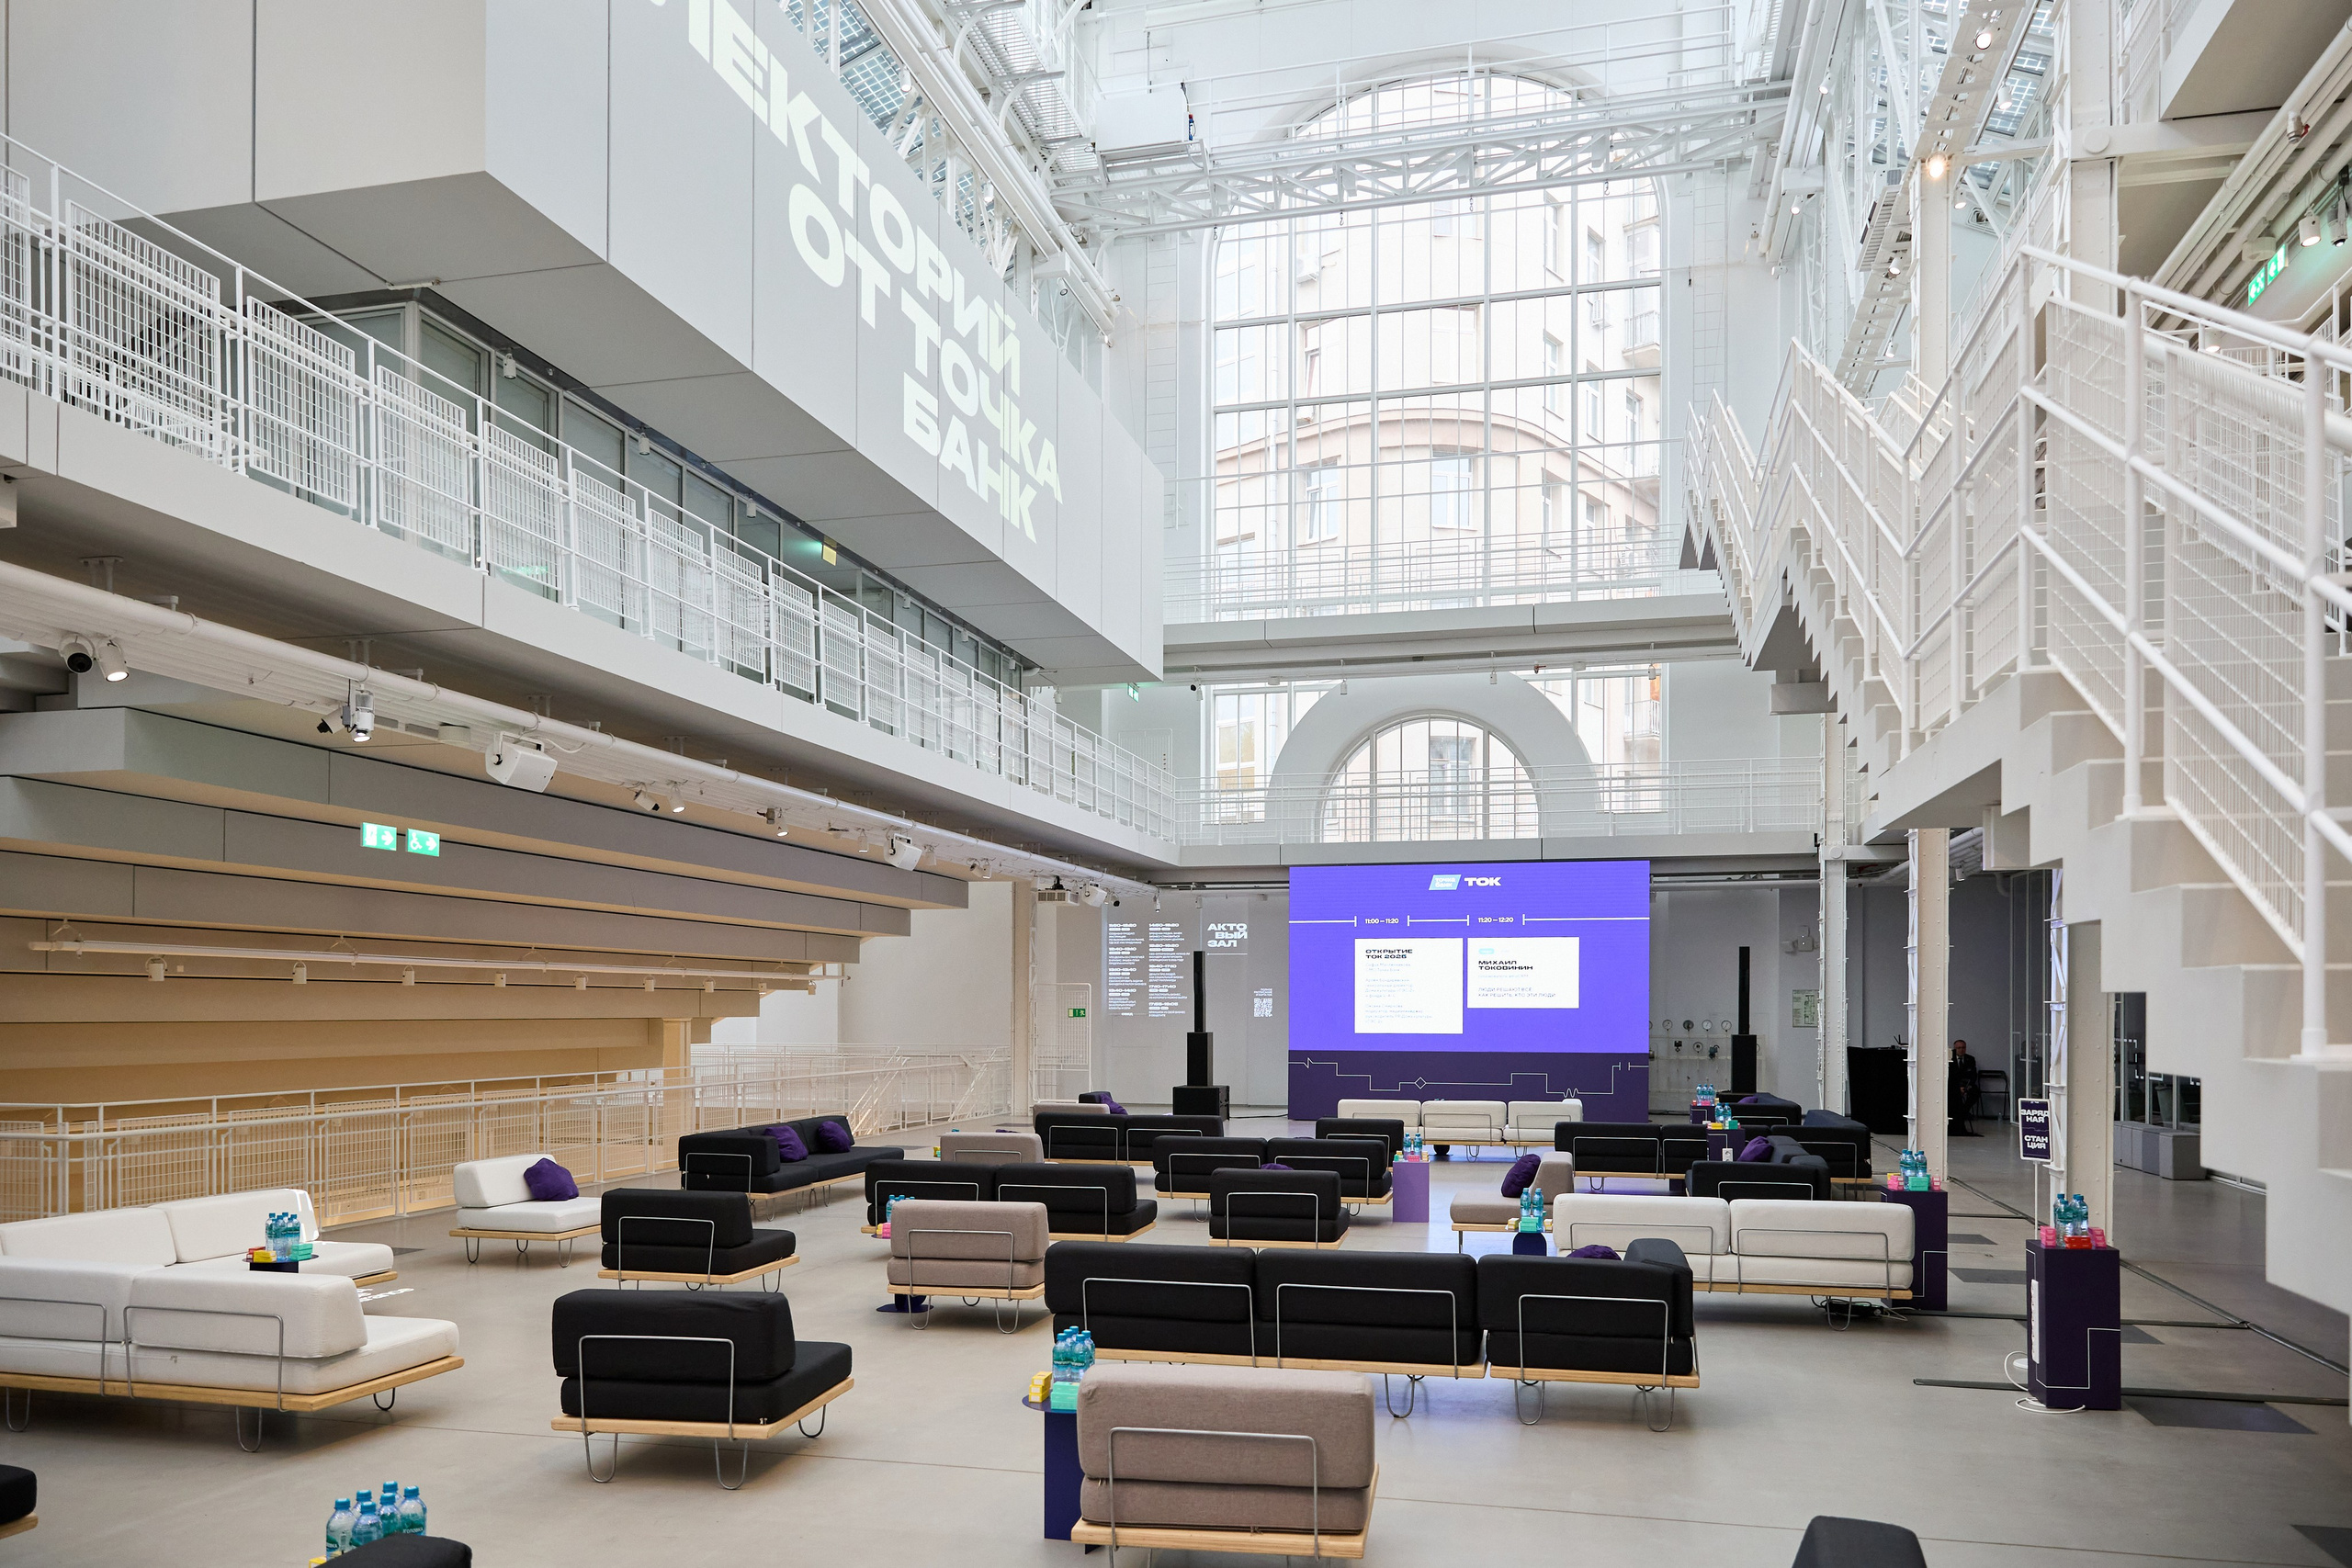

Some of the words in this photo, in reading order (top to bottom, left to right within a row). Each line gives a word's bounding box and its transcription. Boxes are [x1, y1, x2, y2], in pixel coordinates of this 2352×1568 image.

[788, 183, 891, 330] ОТ
[900, 287, 1064, 505] ТОЧКА
[903, 371, 1037, 544] БАНК
[1464, 876, 1502, 886] ТОК
[1207, 923, 1248, 931] АКТО
[1215, 931, 1248, 940] ВЫЙ
[1207, 940, 1238, 948] ЗАЛ
